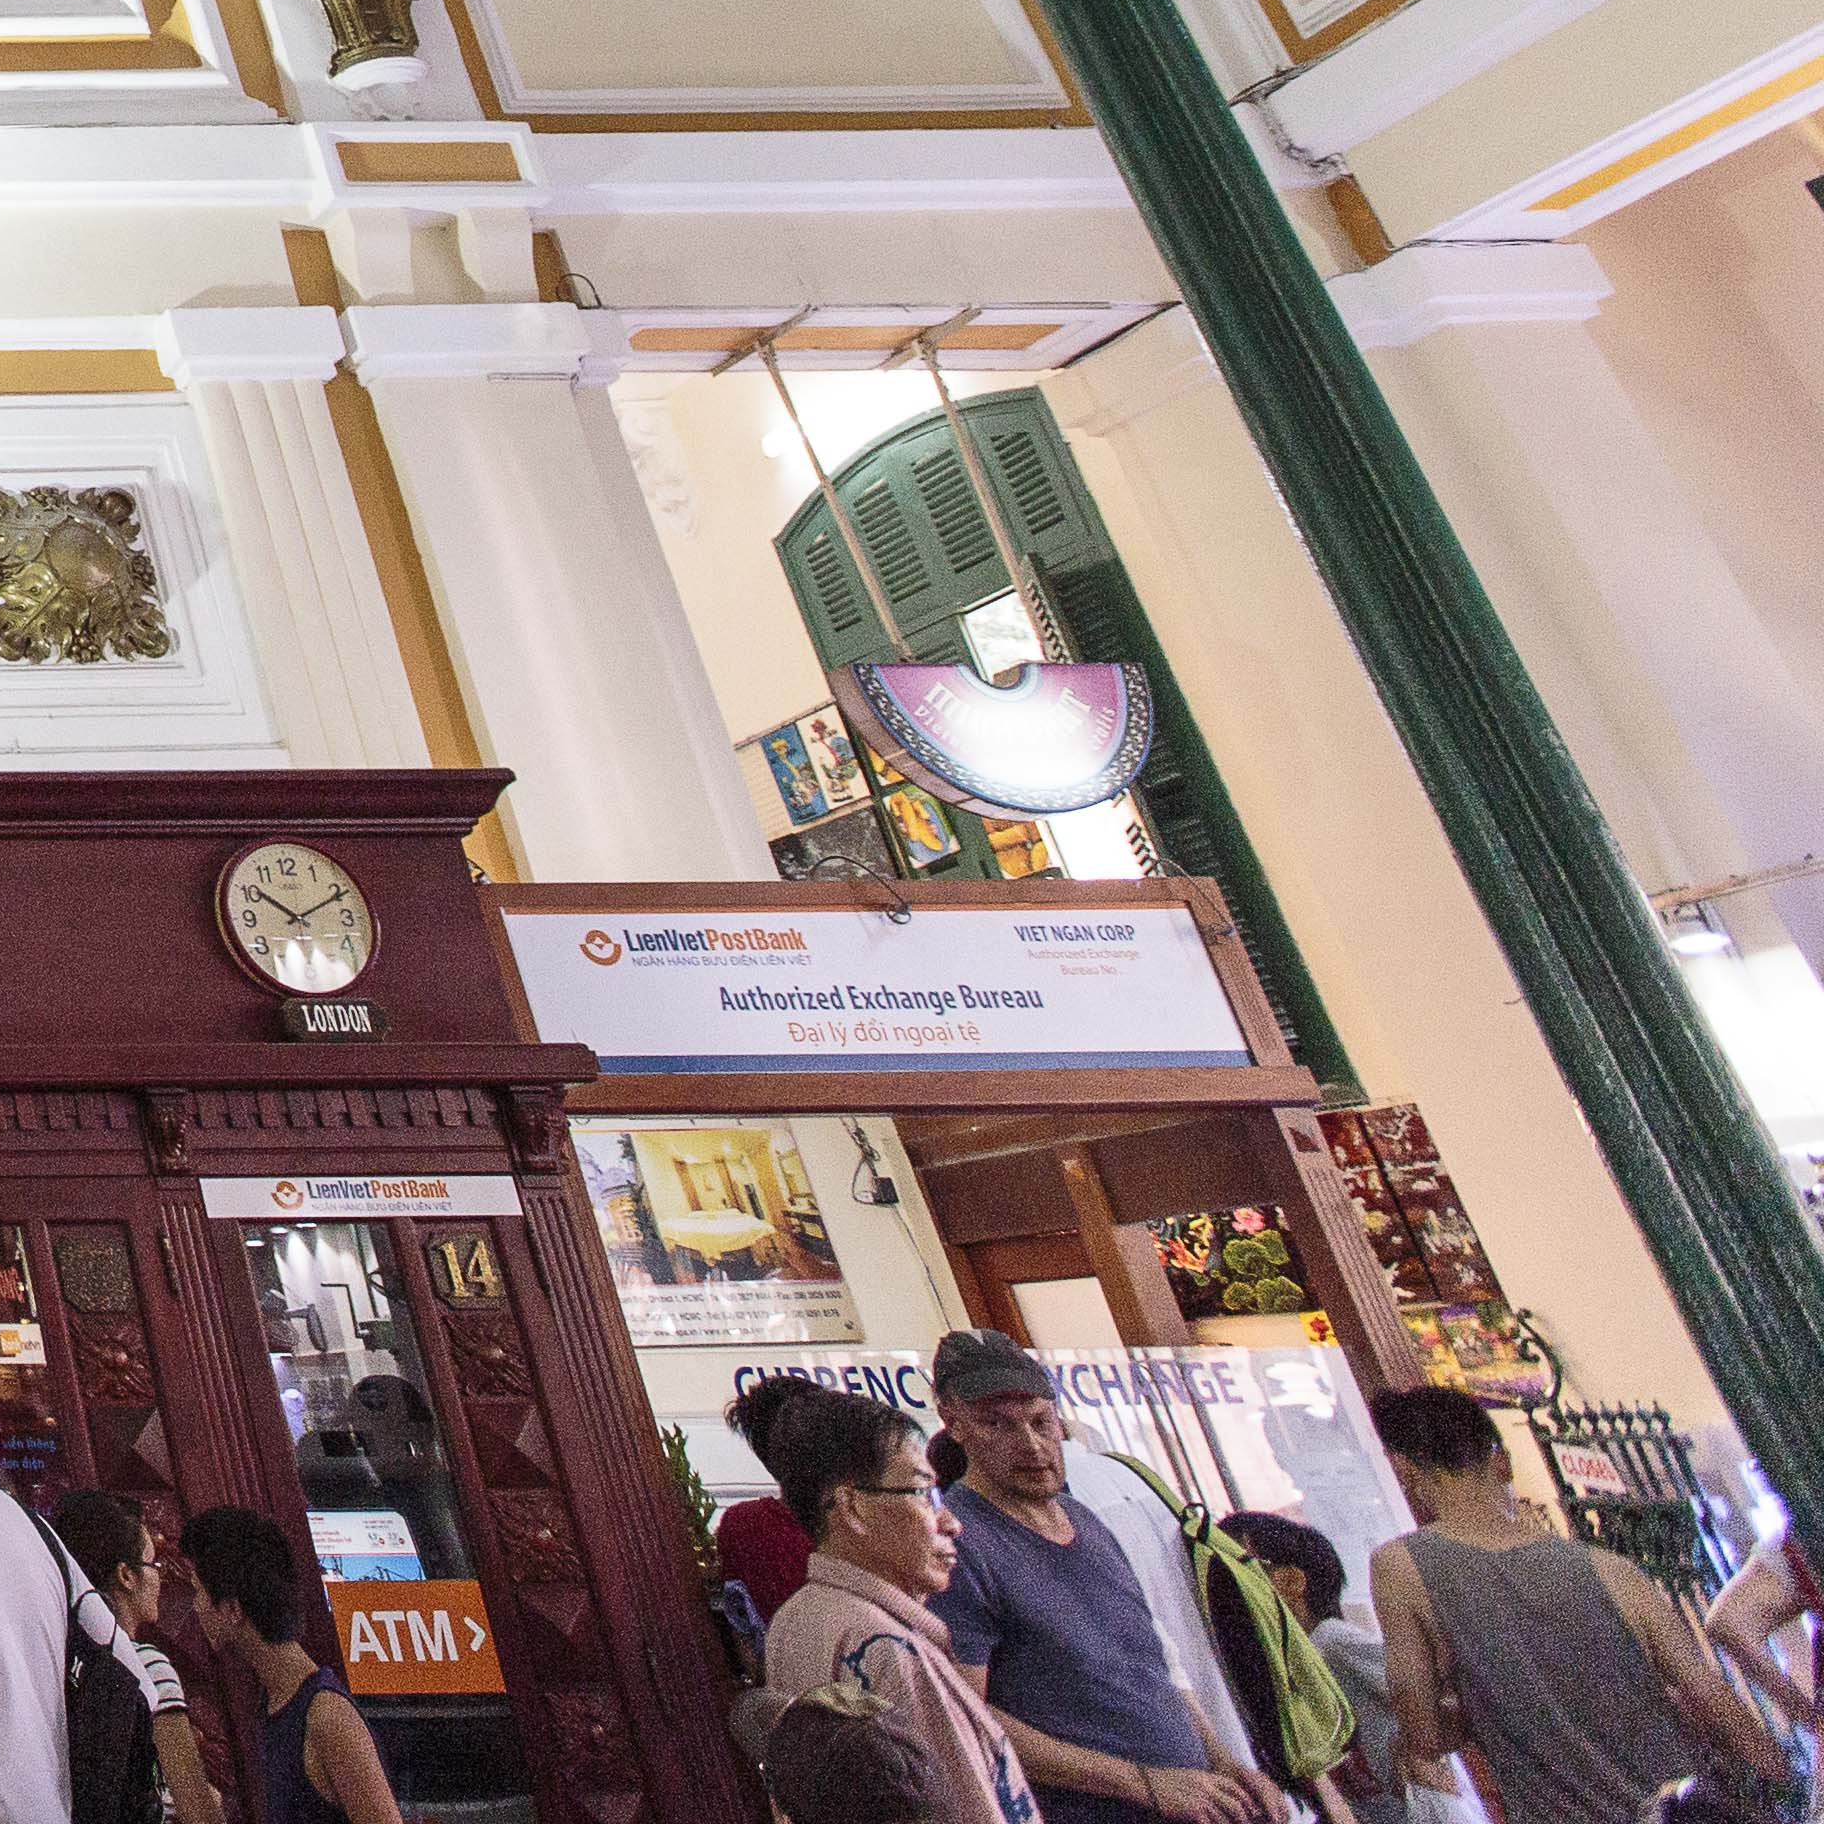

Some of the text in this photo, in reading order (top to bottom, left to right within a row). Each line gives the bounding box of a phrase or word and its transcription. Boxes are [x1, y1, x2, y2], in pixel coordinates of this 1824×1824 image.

[623, 927, 808, 951] LienVietPostBank
[1013, 924, 1135, 942] VIET NGAN CORP
[719, 984, 1046, 1015] Authorized Exchange Bureau
[301, 1005, 372, 1033] LONDON
[788, 1017, 981, 1048] Đại lý đổi ngoại tệ
[306, 1179, 449, 1199] LienVietPostBank
[436, 1239, 496, 1298] 14
[1042, 1360, 1244, 1408] XCHANGE
[349, 1610, 459, 1663] ATM
